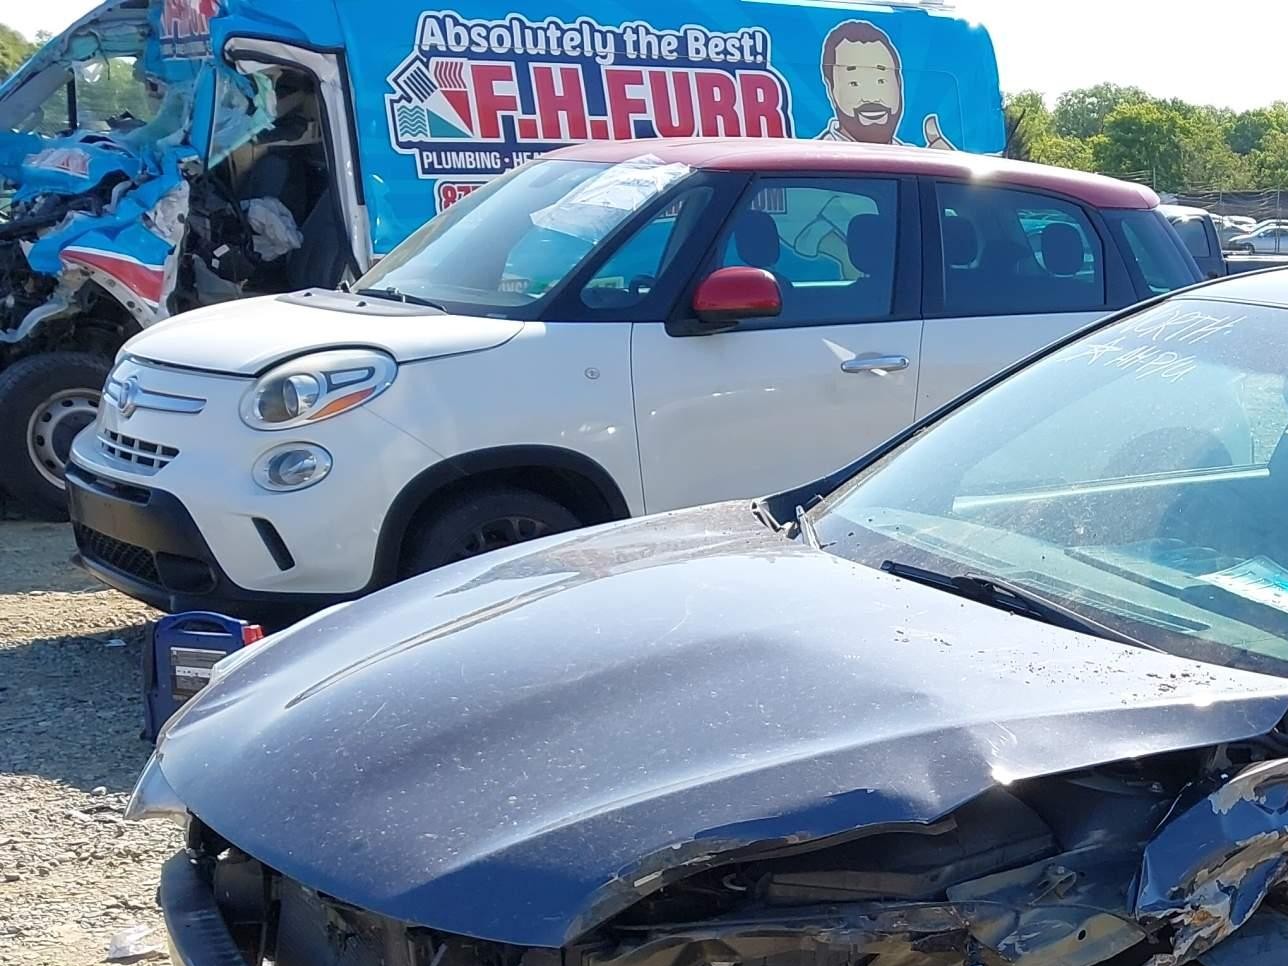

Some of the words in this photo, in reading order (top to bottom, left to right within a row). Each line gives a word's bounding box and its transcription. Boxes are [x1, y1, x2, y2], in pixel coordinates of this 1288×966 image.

[420, 17, 616, 64] Absolutely
[624, 25, 678, 60] the
[687, 29, 763, 63] Best!
[422, 151, 501, 169] PLUMBING
